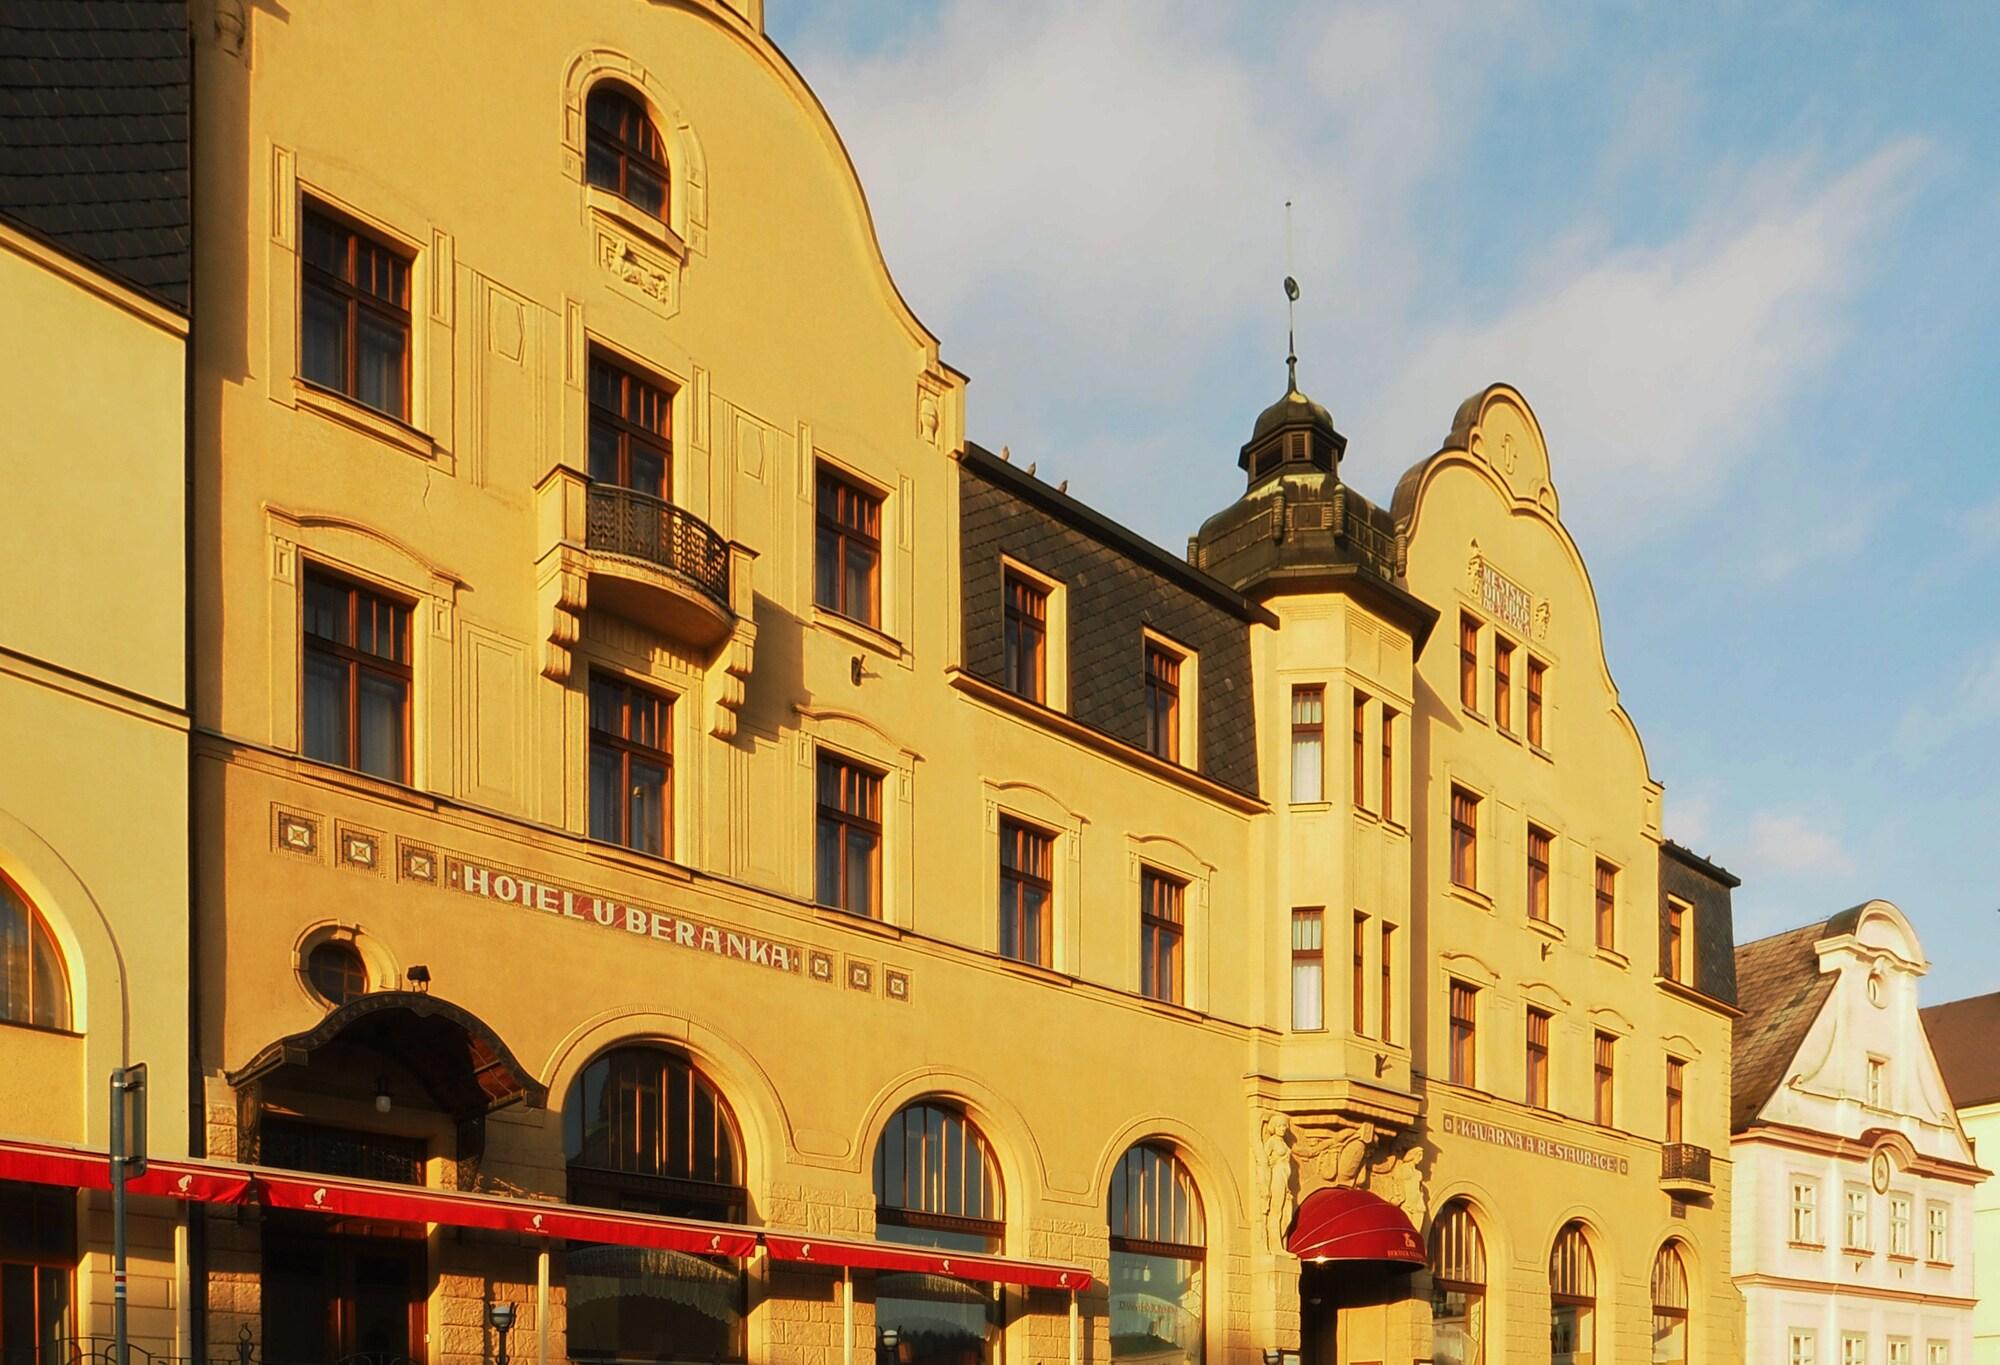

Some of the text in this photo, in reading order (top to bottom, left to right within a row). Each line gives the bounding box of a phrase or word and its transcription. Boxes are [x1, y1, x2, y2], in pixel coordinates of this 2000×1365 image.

[464, 864, 584, 919] HOTEL
[593, 898, 615, 926] U
[1526, 1136, 1535, 1153] A
[1538, 1140, 1615, 1172] RESTAURACE
